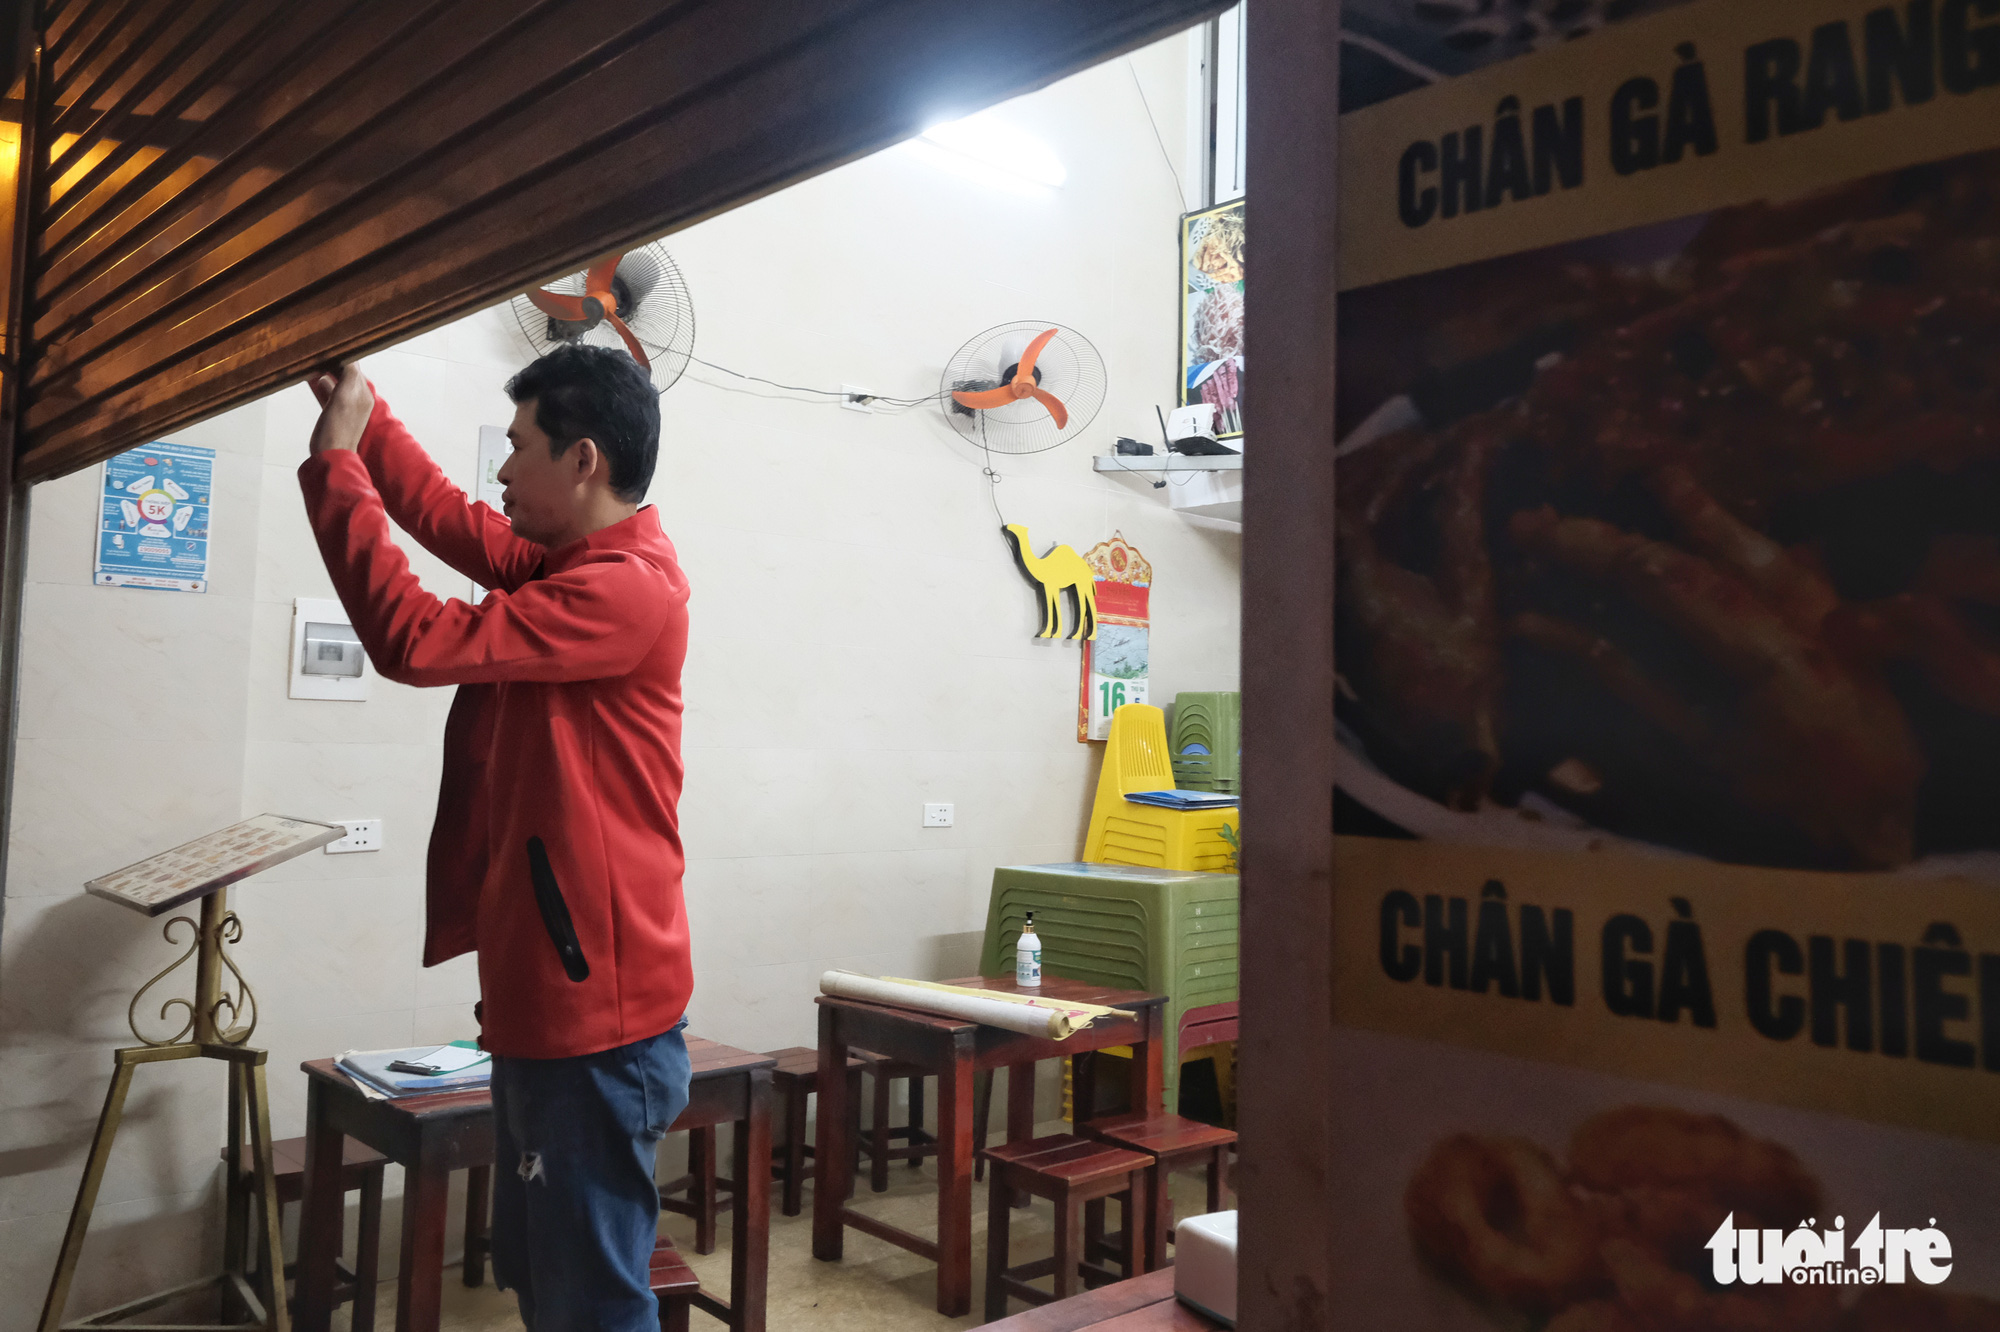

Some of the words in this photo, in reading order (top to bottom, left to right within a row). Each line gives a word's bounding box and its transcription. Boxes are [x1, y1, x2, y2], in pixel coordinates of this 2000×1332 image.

[1398, 95, 1584, 228] CHÂN
[1610, 42, 1719, 176] GÀ
[148, 504, 166, 516] 5K
[1099, 681, 1126, 717] 16
[1379, 880, 1575, 1007] CHÂN
[1602, 897, 1717, 1029] GÀ
